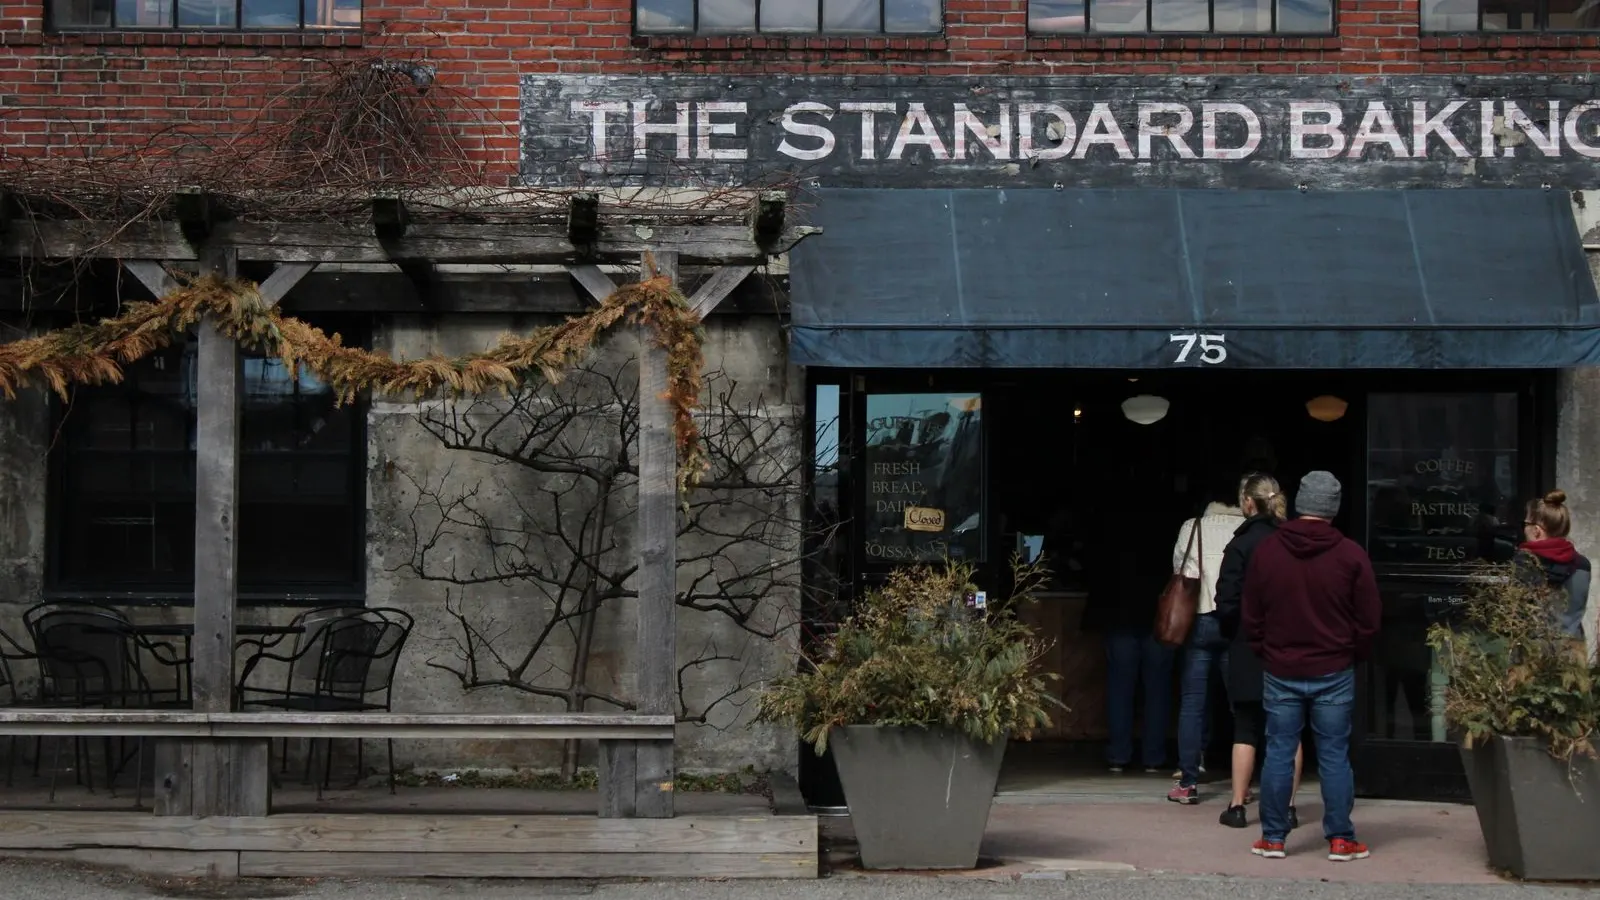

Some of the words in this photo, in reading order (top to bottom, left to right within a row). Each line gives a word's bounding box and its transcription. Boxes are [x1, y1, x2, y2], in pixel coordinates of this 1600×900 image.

[571, 101, 748, 161] THE
[776, 101, 1261, 161] STANDARD
[1170, 333, 1227, 364] 75
[873, 462, 921, 476] FRESH
[1415, 459, 1475, 474] COFFEE
[872, 481, 922, 495] BREAD
[1411, 502, 1480, 516] PASTRIES
[908, 510, 942, 526] Closed
[1425, 546, 1466, 560] TEAS
